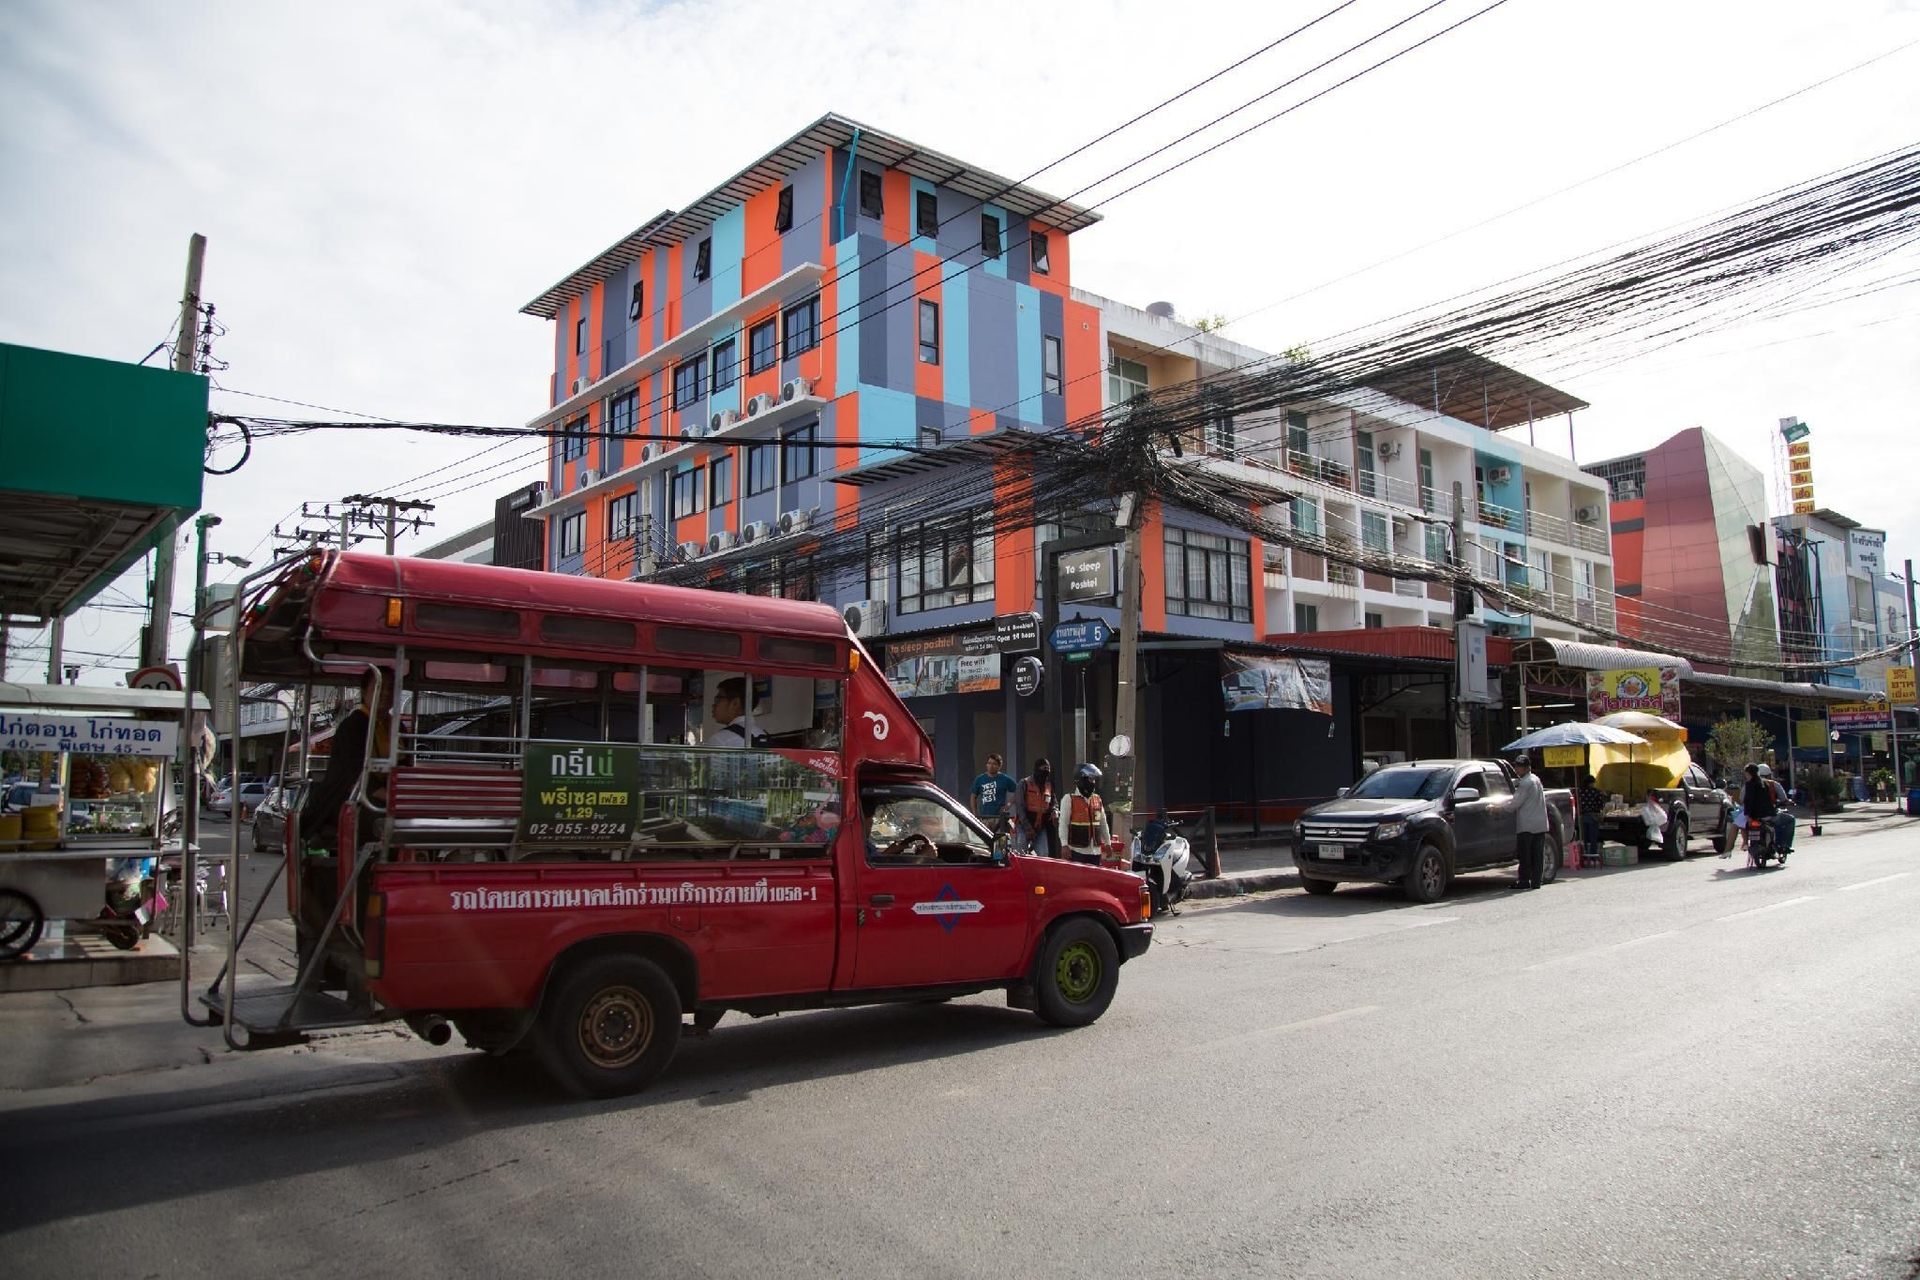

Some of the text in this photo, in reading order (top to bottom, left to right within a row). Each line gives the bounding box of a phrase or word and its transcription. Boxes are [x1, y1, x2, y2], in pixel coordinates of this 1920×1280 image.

[1079, 562, 1100, 572] sleep
[1094, 626, 1102, 641] 5
[900, 641, 922, 653] sleep
[923, 635, 954, 652] poshtel
[960, 660, 973, 668] Free
[0, 715, 161, 742] ไก่ตอน ไก่ทอด
[58, 738, 105, 752] พิเศษ
[541, 786, 597, 806] พรีเซล
[619, 795, 627, 804] 2
[565, 806, 594, 819] 1.29
[529, 823, 627, 835] 02-055-9224
